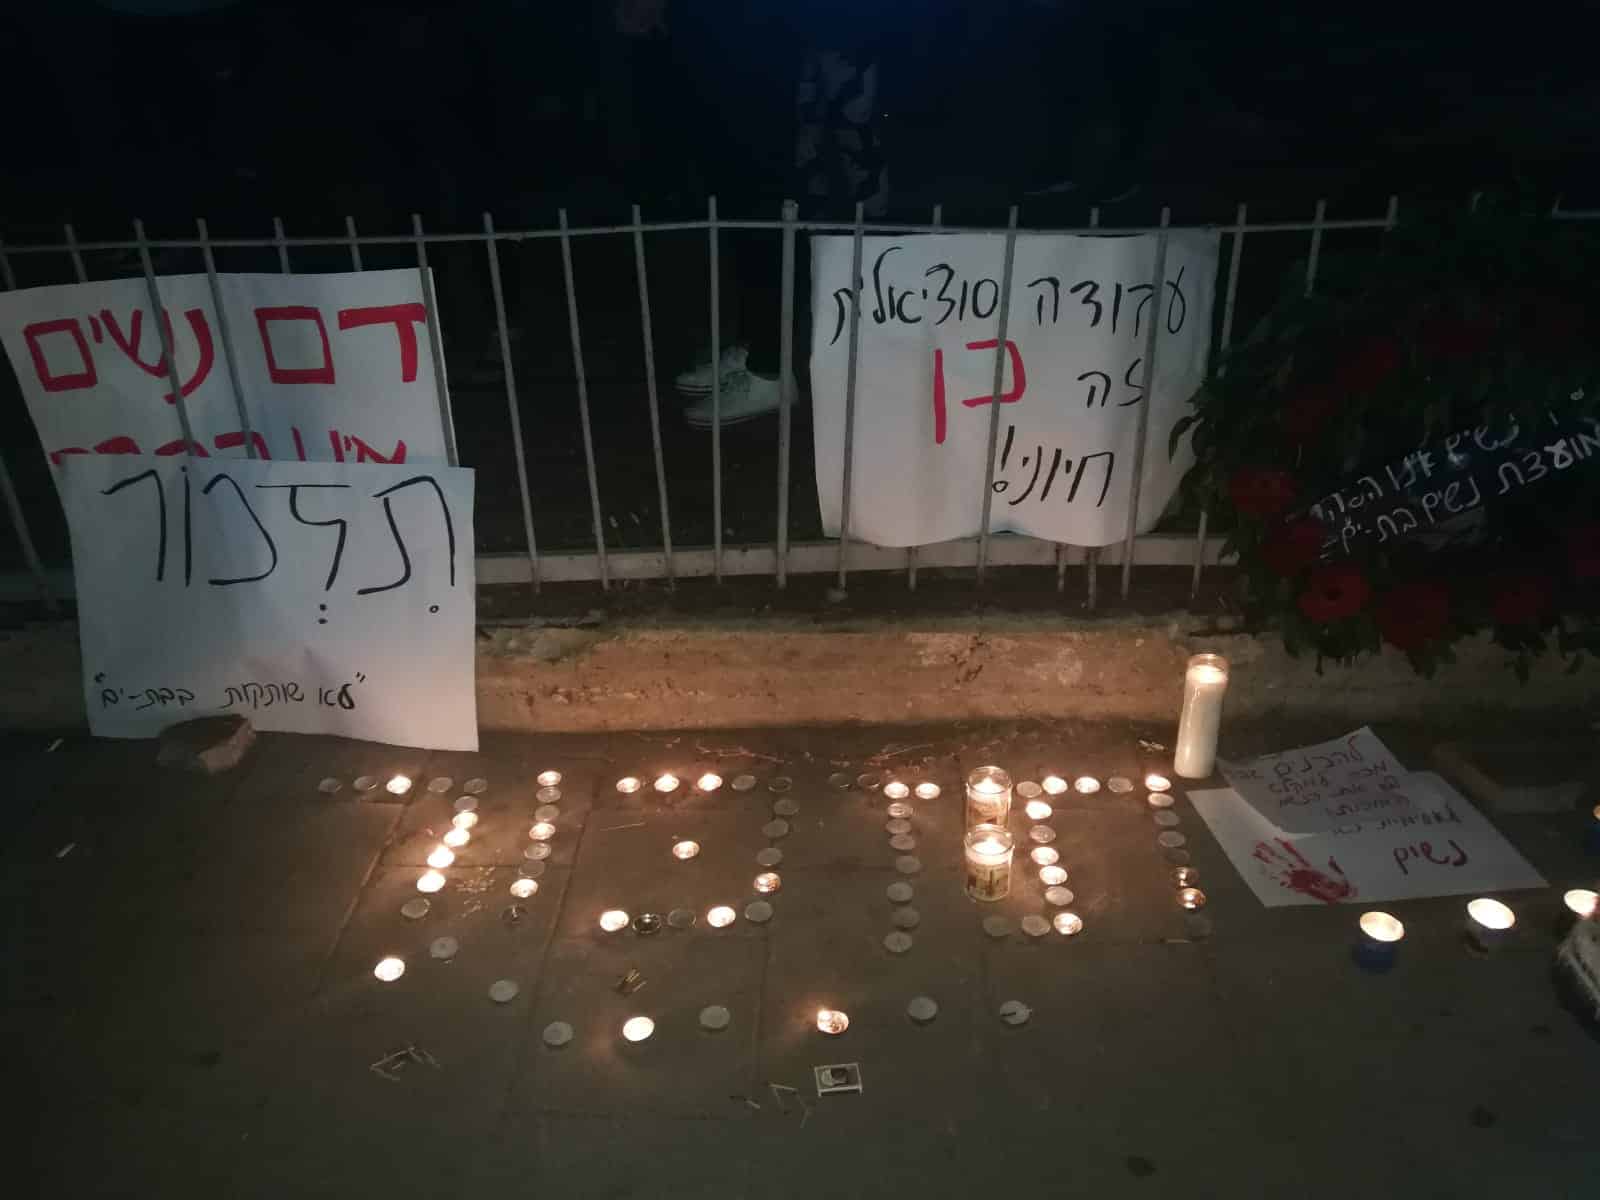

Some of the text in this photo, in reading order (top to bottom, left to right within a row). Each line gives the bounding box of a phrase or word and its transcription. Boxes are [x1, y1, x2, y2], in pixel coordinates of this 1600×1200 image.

[24, 303, 427, 405] דם נשים
[934, 339, 1145, 444] זה כן
[991, 425, 1115, 507] חיוני!
